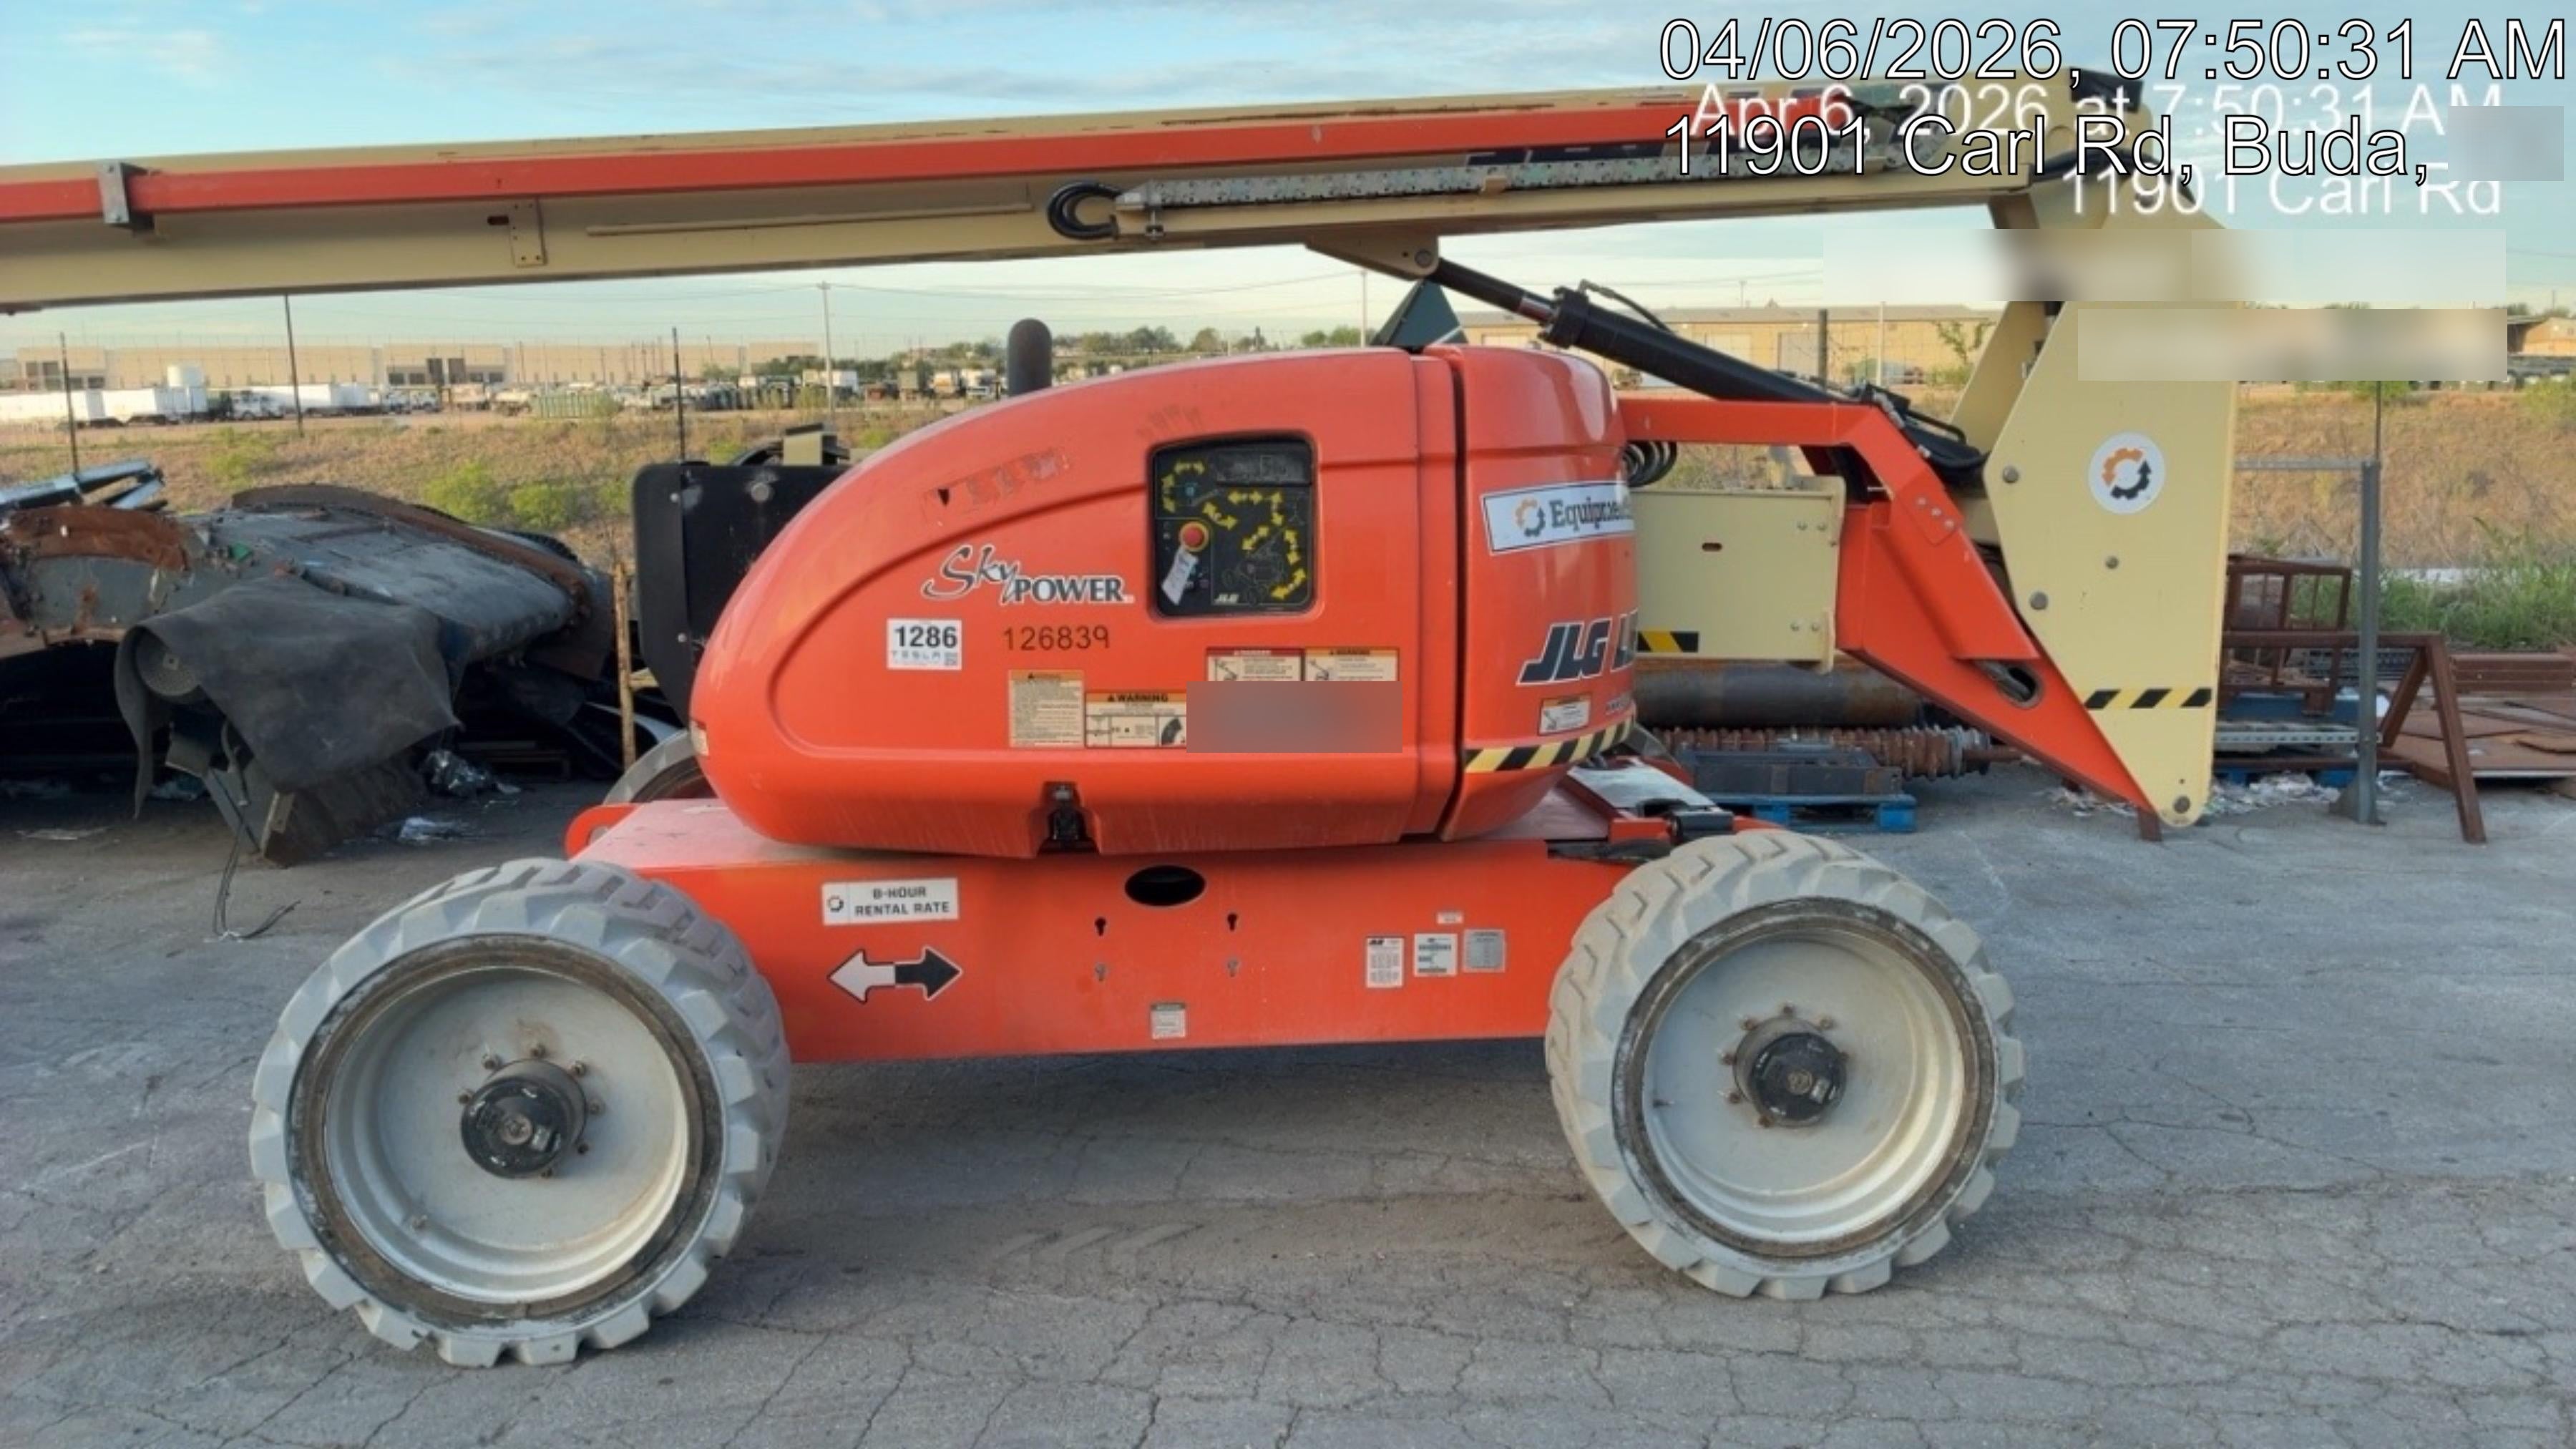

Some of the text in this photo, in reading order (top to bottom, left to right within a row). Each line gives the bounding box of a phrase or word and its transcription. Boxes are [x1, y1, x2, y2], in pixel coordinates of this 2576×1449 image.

[894, 624, 957, 648] 1286
[1003, 625, 1110, 651] 126839
[1516, 618, 1612, 686] JLG
[1117, 693, 1169, 703] WARNING
[854, 902, 950, 916] RENTAL RATE
